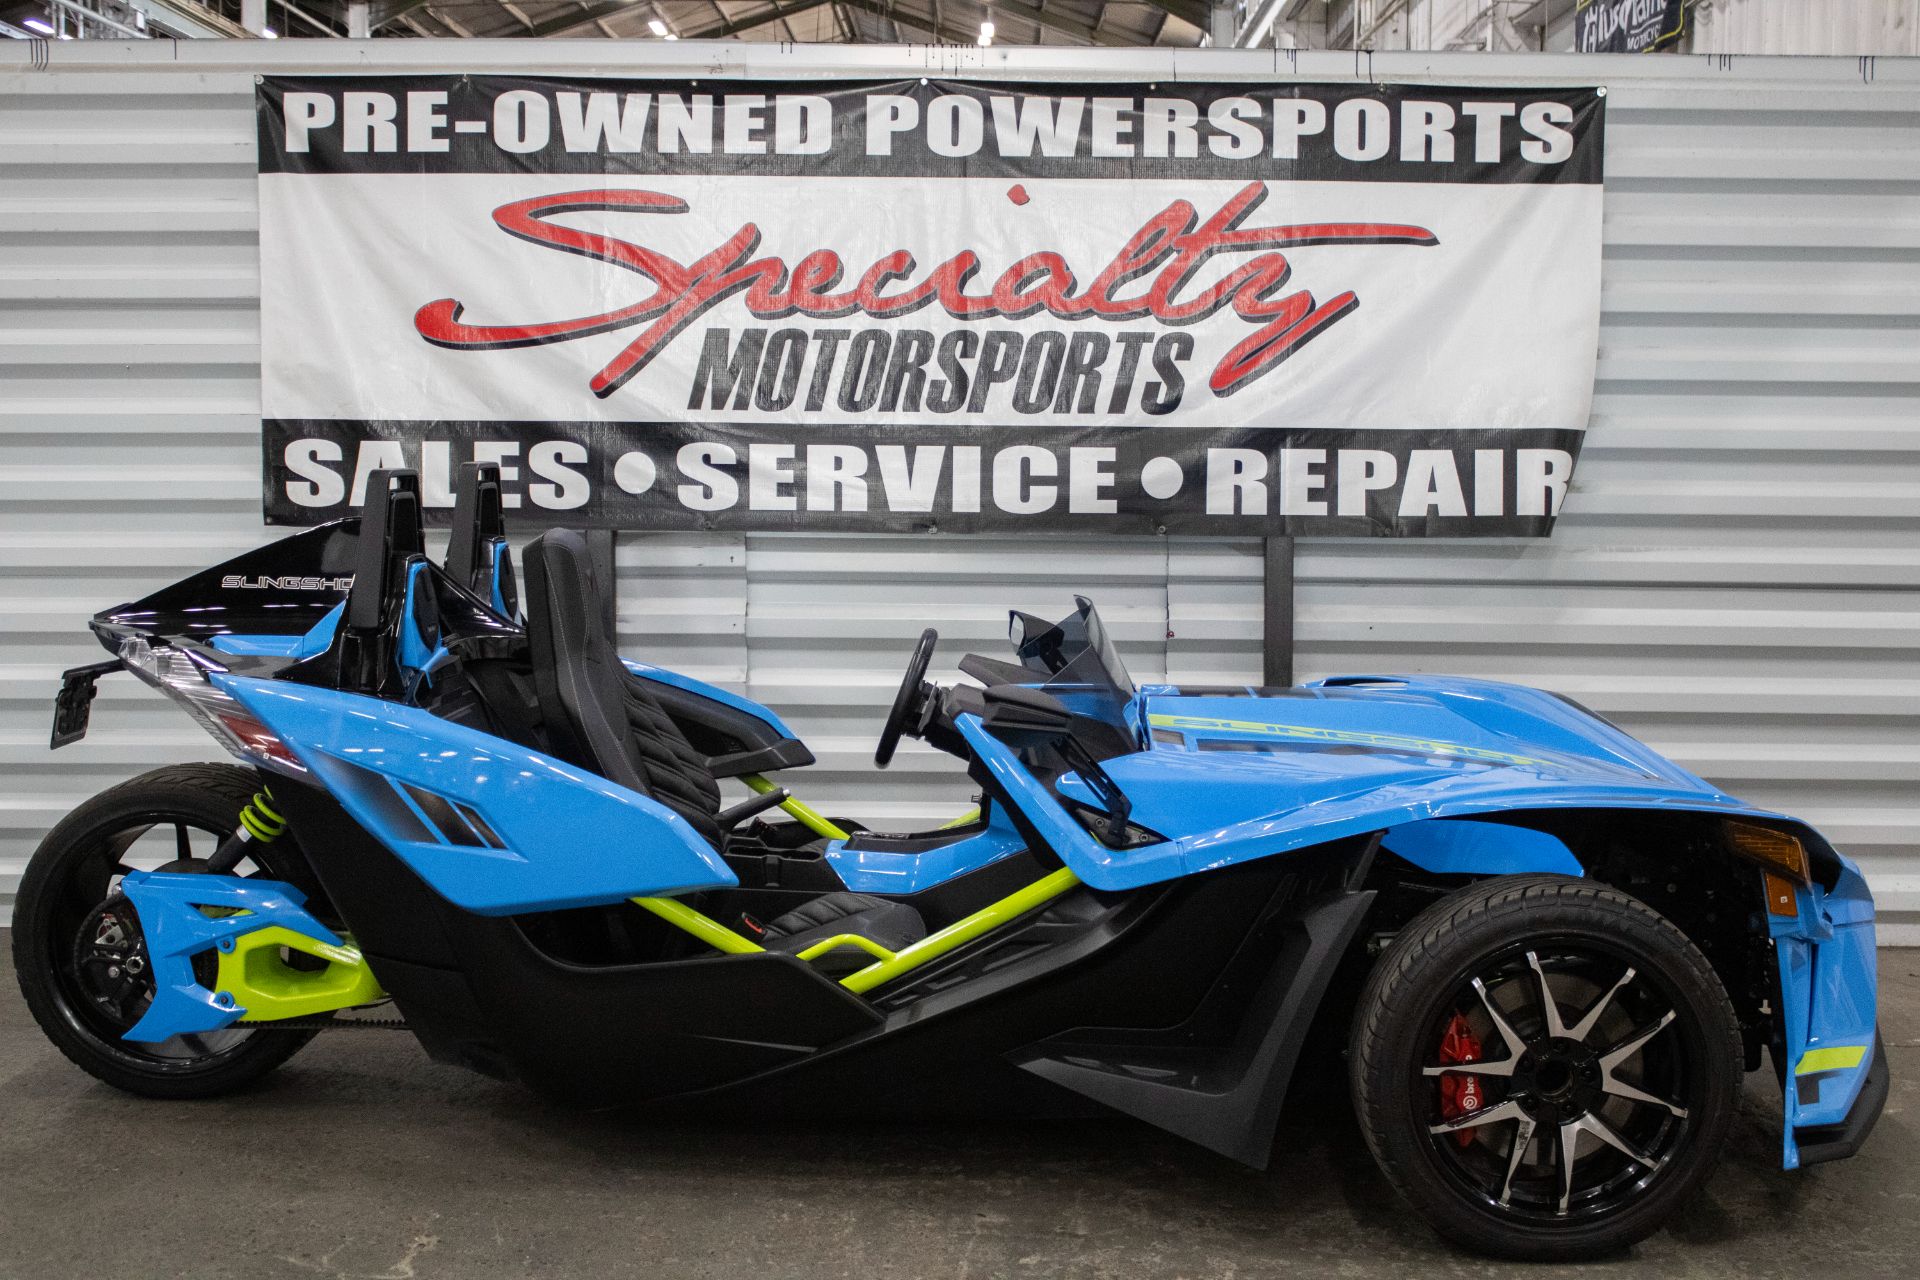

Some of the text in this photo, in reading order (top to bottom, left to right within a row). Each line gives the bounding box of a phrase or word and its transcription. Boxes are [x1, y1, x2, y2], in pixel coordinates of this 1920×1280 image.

[283, 90, 1574, 164] PRE-OWNED POWERSPORTS
[414, 180, 1440, 398] Specialty
[687, 327, 1195, 416] MOTORSPORTS
[284, 438, 1573, 518] SALES SERVICE REPAIR
[221, 575, 354, 590] SLINGSHO
